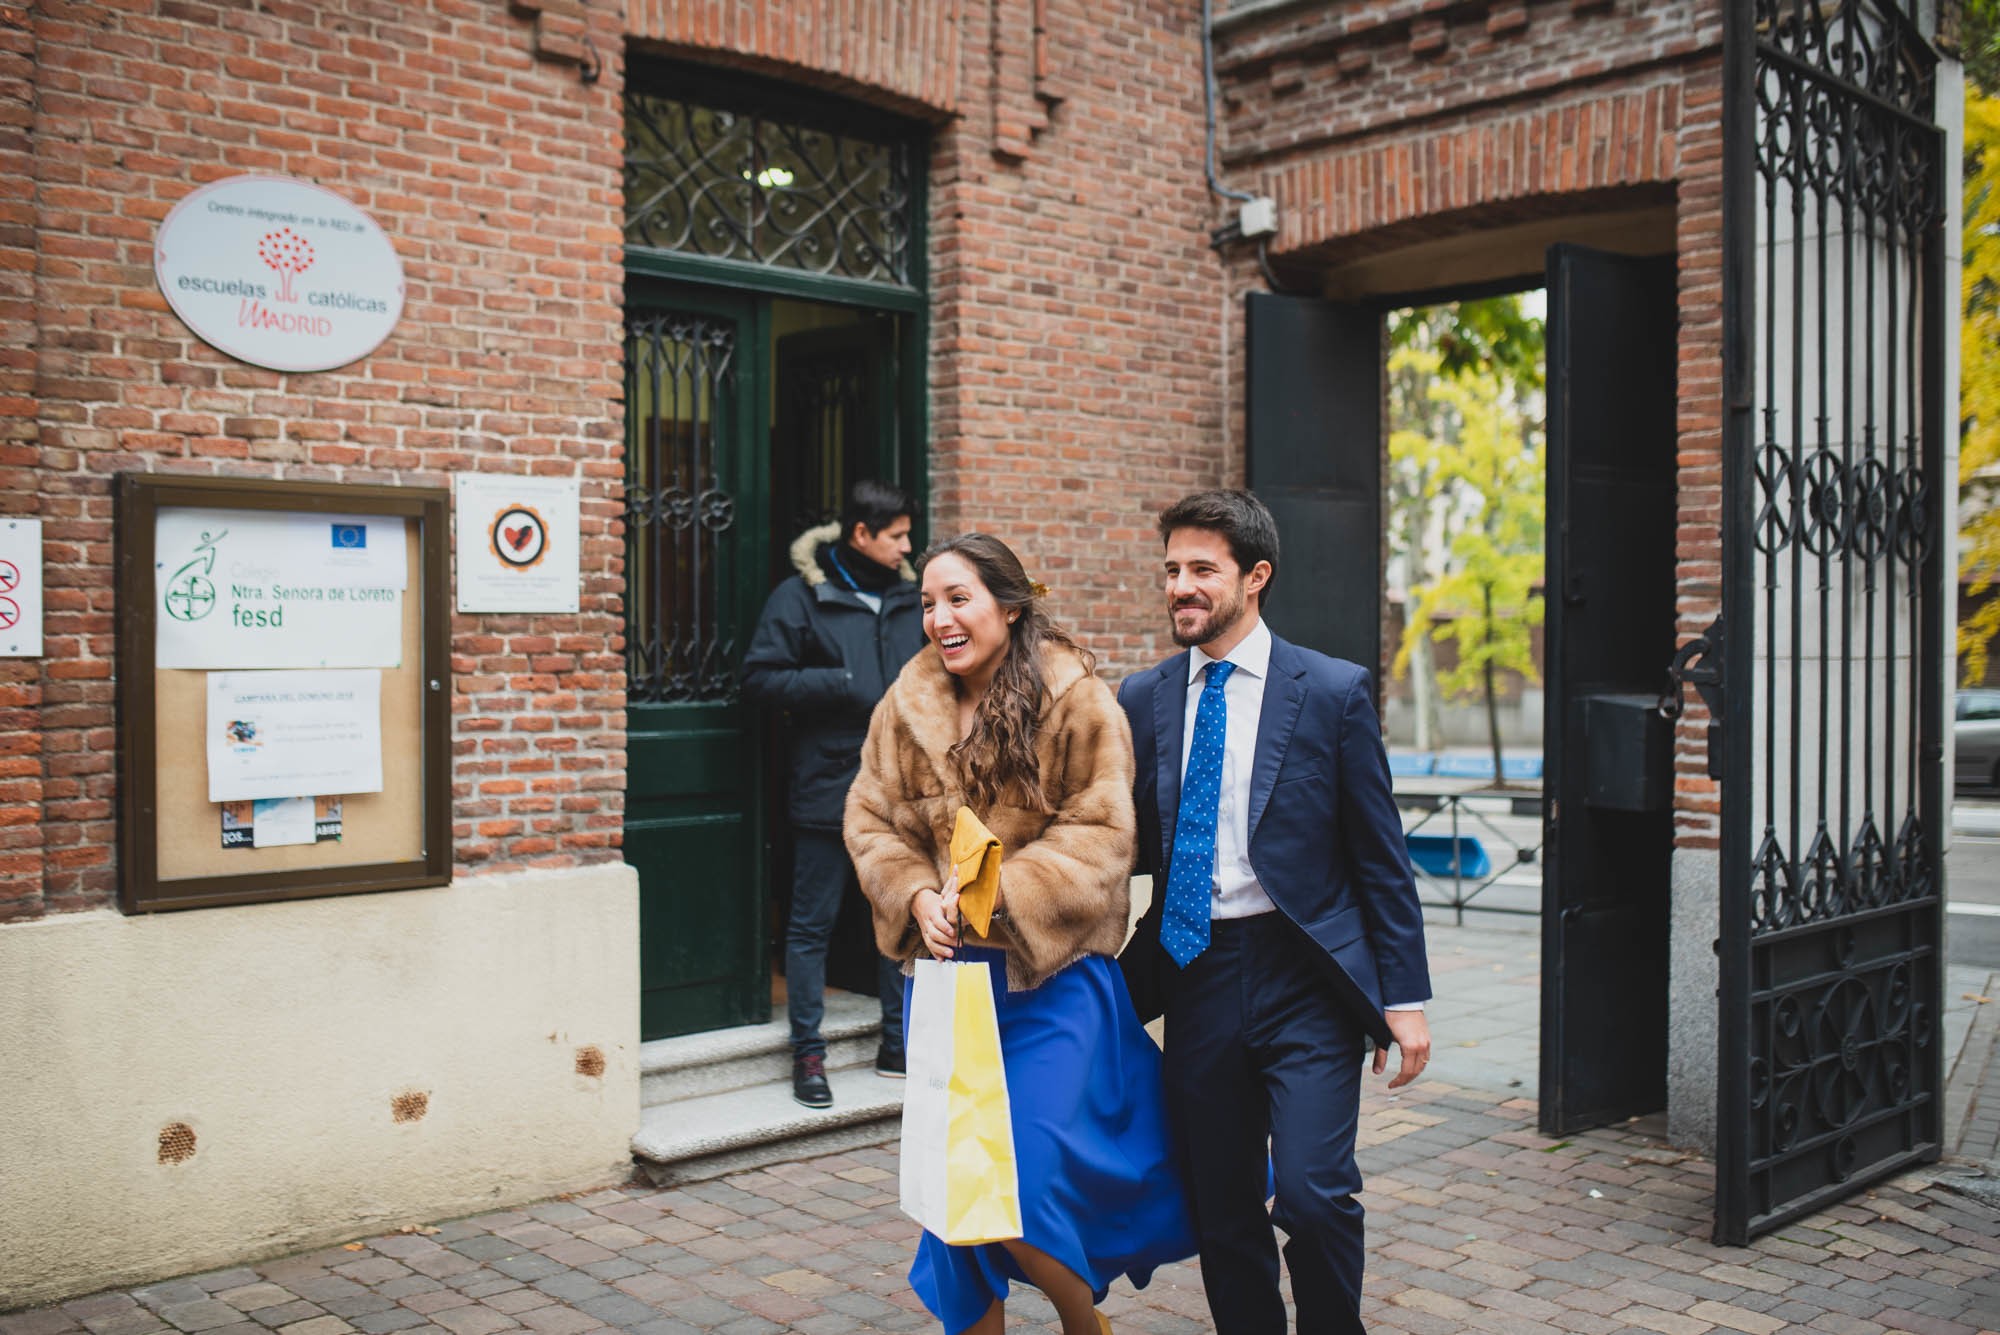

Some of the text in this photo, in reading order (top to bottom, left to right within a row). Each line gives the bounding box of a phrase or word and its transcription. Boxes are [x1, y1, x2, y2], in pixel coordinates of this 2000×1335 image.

[178, 274, 388, 314] escuelas católicas
[237, 297, 333, 337] MADRID
[327, 584, 345, 601] de
[350, 586, 395, 601] Loreto
[232, 603, 283, 628] fesd
